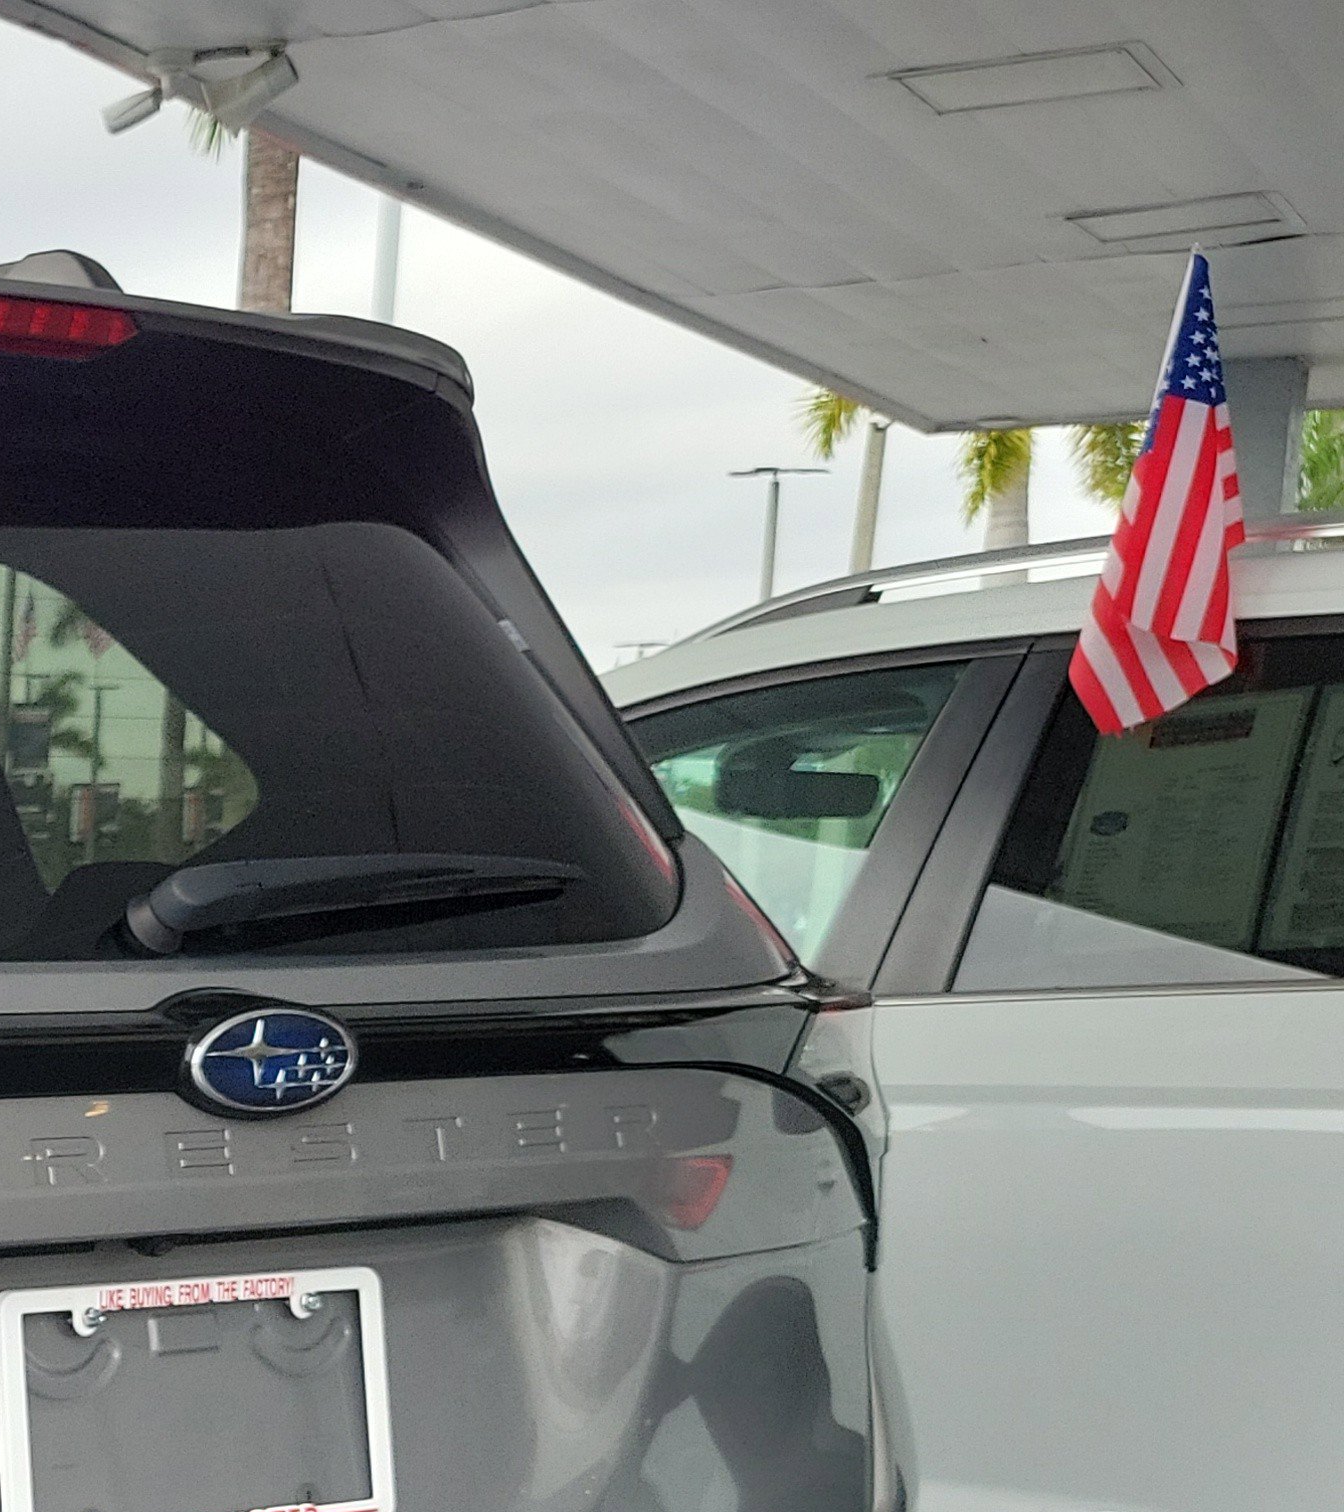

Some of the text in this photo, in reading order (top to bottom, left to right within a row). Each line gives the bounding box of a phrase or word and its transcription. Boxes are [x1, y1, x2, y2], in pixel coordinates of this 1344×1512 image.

[99, 1277, 295, 1310] LIKE BUYING FROM THE FACTORY!
